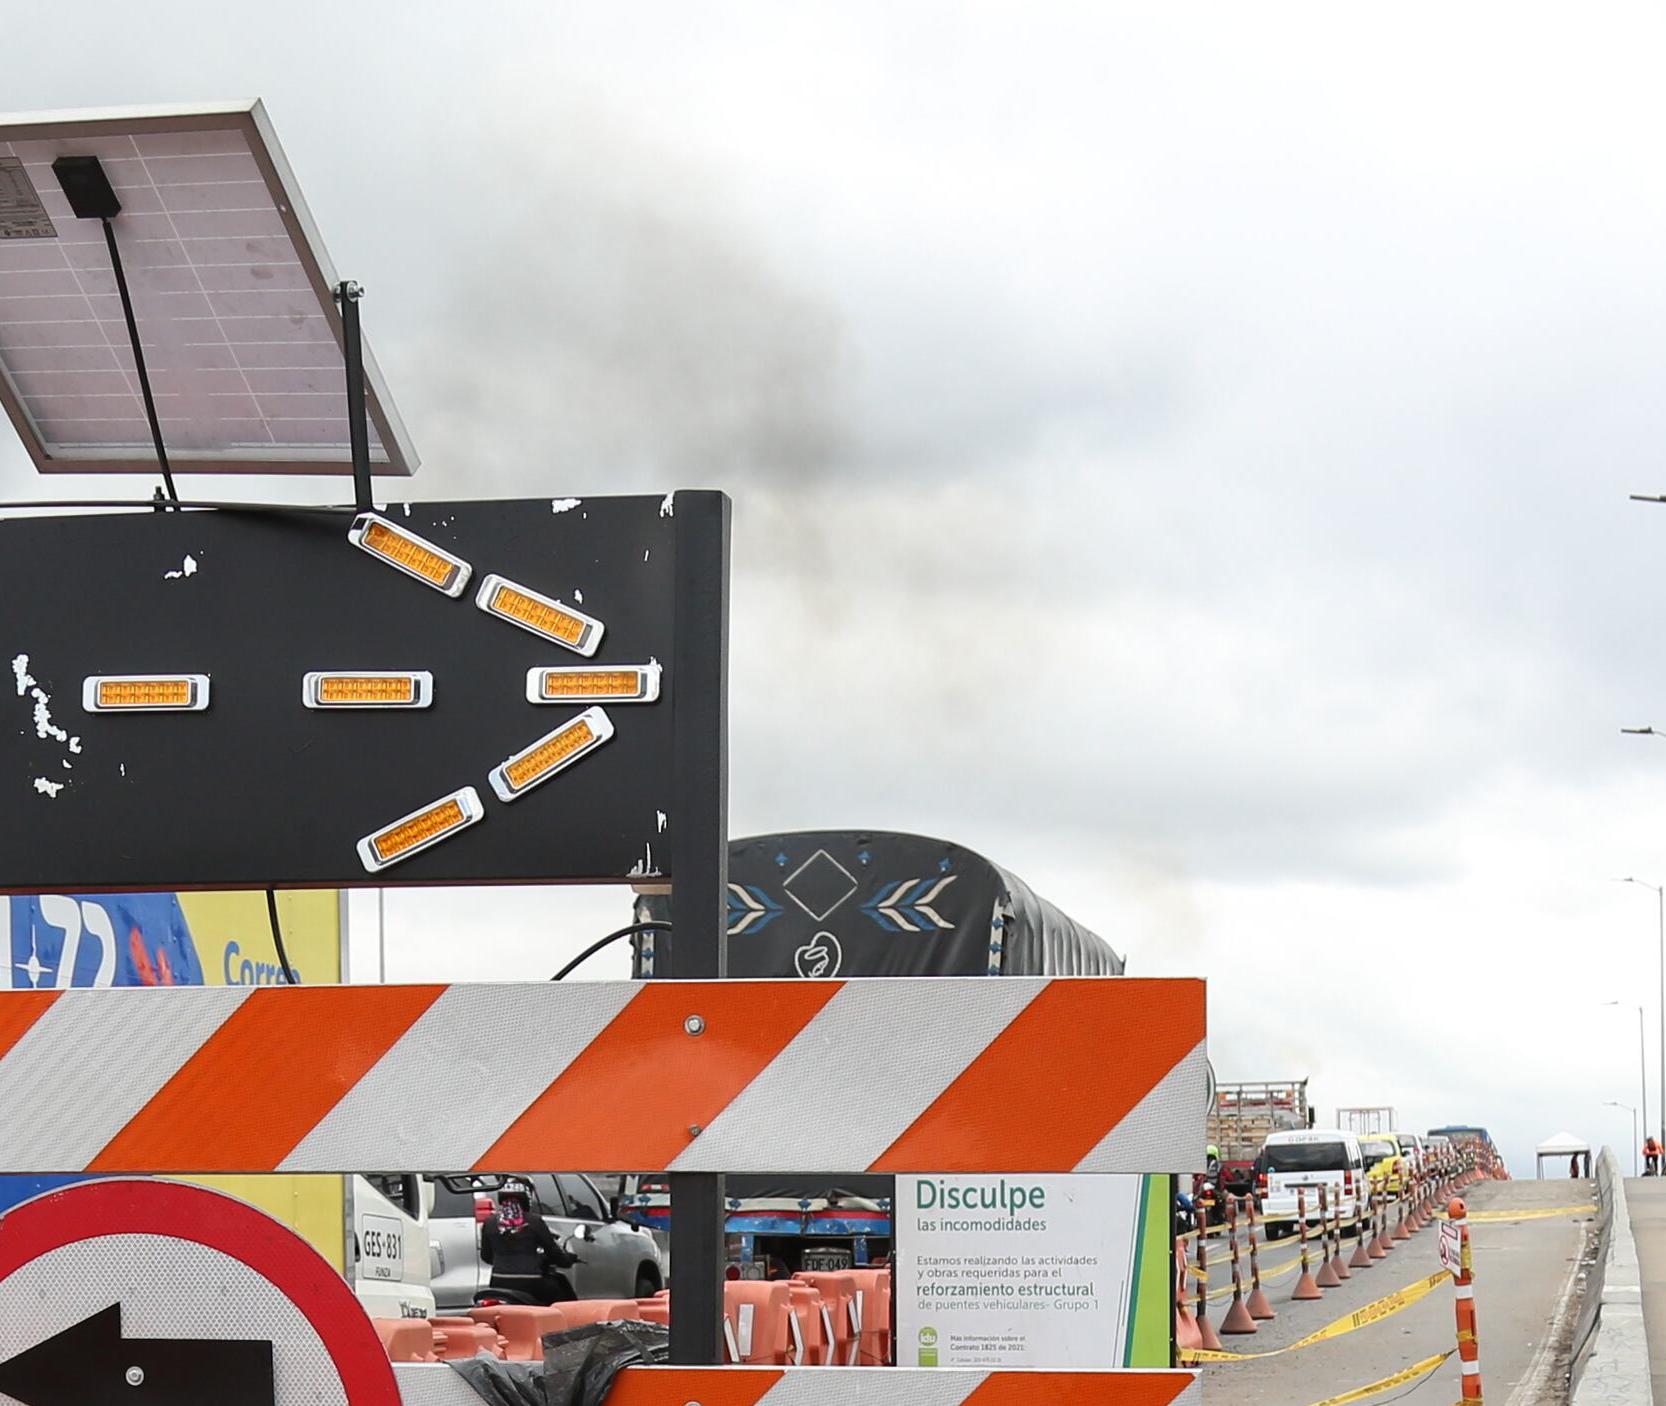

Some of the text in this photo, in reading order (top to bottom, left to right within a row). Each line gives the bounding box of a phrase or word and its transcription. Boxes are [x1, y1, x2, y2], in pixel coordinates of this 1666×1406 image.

[916, 1179, 1046, 1217] Disculpe
[917, 1218, 1047, 1232] las incomodidades
[917, 1256, 1099, 1266] Estamos realizando las actividades
[917, 1267, 1062, 1280] y obras requeridas para el
[916, 1282, 1095, 1297] reforzamiento estructural
[918, 1300, 933, 1310] de
[935, 1301, 980, 1312] puentes
[1054, 1300, 1090, 1312] Grupo
[1093, 1300, 1099, 1310] 1
[950, 1343, 980, 1351] Contrato
[998, 1343, 1007, 1351] de
